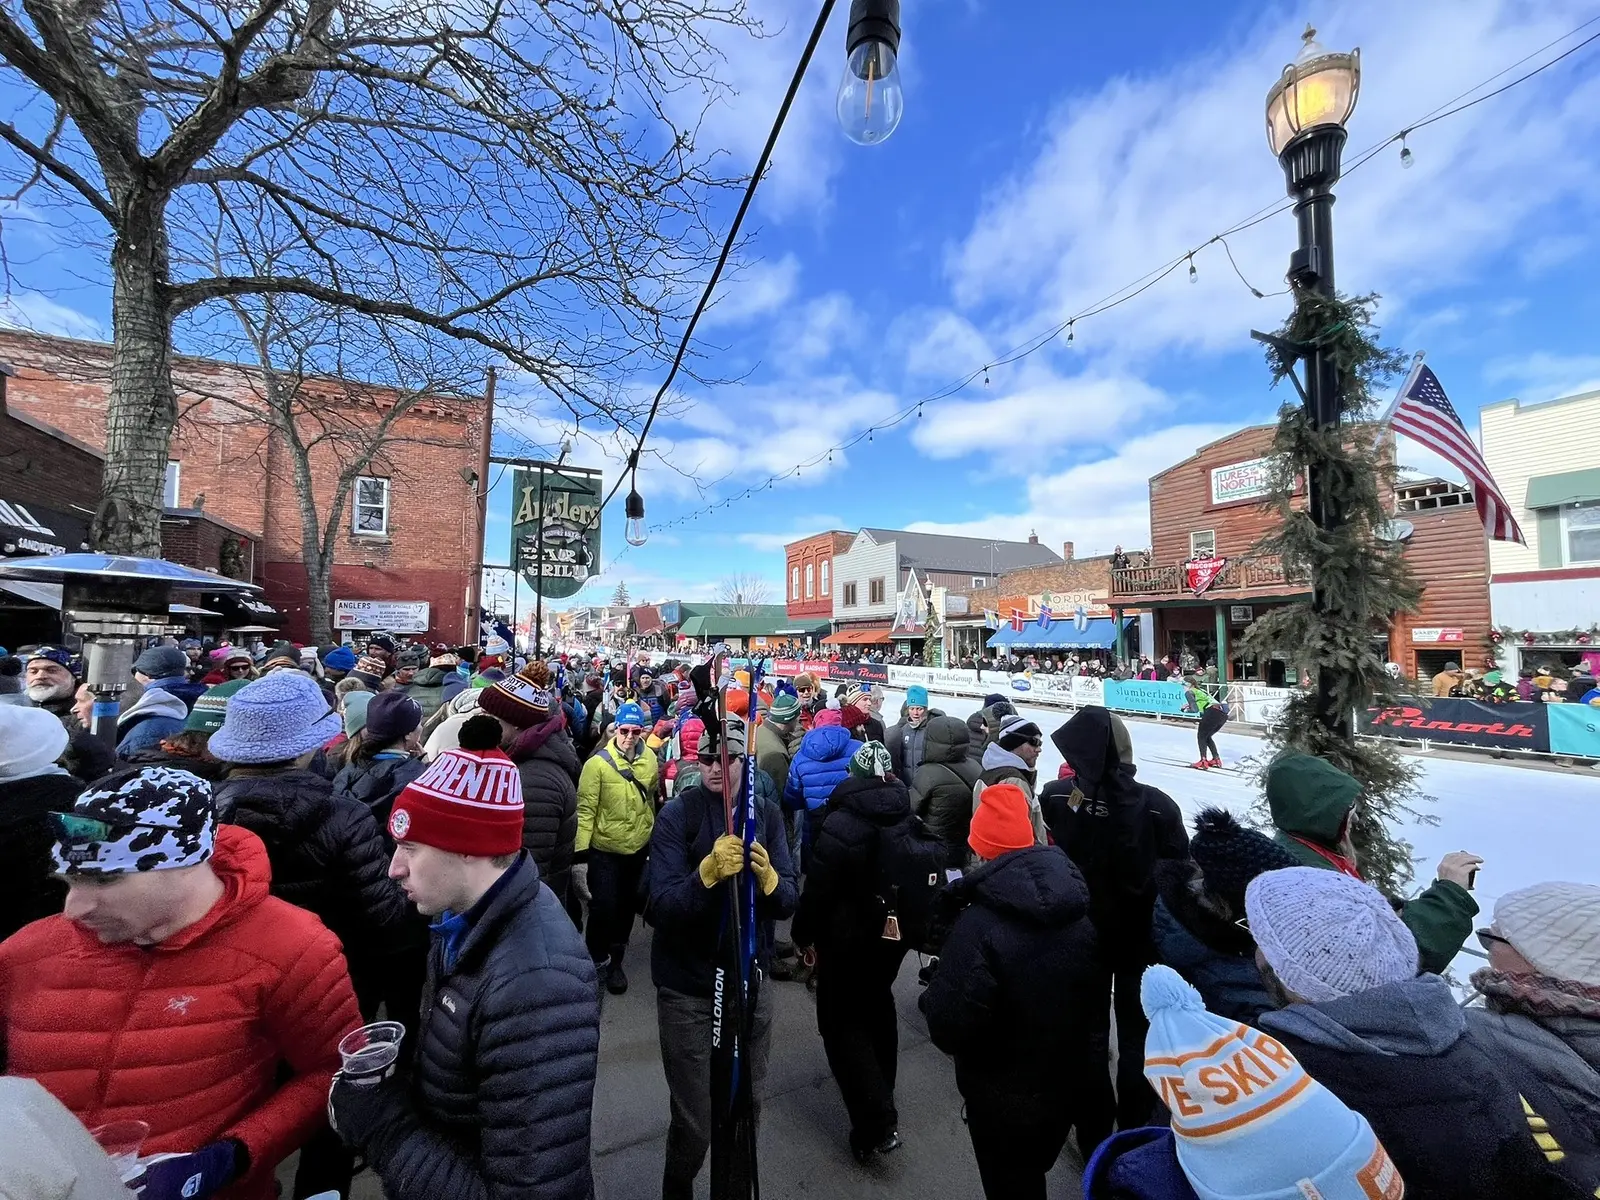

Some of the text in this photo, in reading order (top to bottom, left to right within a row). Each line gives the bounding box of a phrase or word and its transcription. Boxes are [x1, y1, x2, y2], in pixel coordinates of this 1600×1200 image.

[1220, 468, 1249, 482] LURES
[338, 602, 371, 610] ANGLERS
[935, 673, 973, 684] MarksGroup
[1116, 687, 1182, 700] slumberland
[1249, 688, 1282, 698] Hallett
[1367, 706, 1532, 738] Prinoth
[413, 753, 524, 804] BRENTFO
[713, 967, 725, 1049] SALOMON
[1198, 1046, 1278, 1106] SKI
